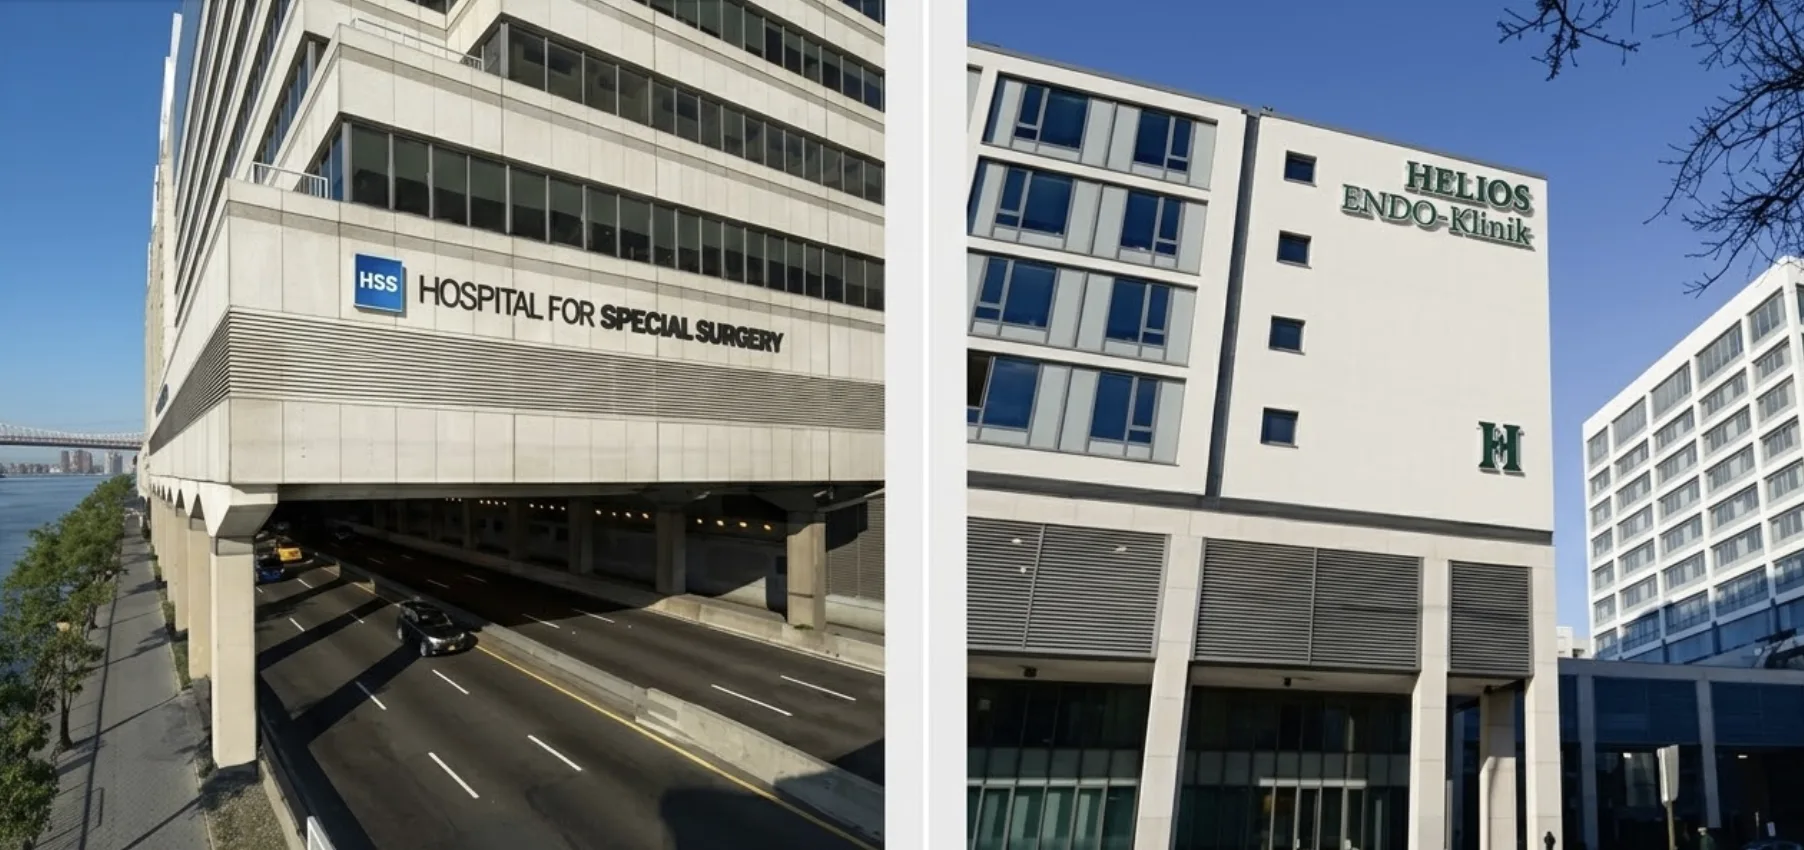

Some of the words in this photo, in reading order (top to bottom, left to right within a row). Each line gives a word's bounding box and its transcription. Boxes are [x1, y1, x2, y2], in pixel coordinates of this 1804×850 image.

[1406, 160, 1531, 211] HELIOS
[1341, 183, 1531, 246] ENDO-Klinik
[359, 271, 398, 293] HSS
[418, 274, 544, 321] HOSPITAL
[548, 295, 595, 328] FOR
[600, 304, 694, 341] SPECIAL
[694, 319, 785, 354] SURGERY
